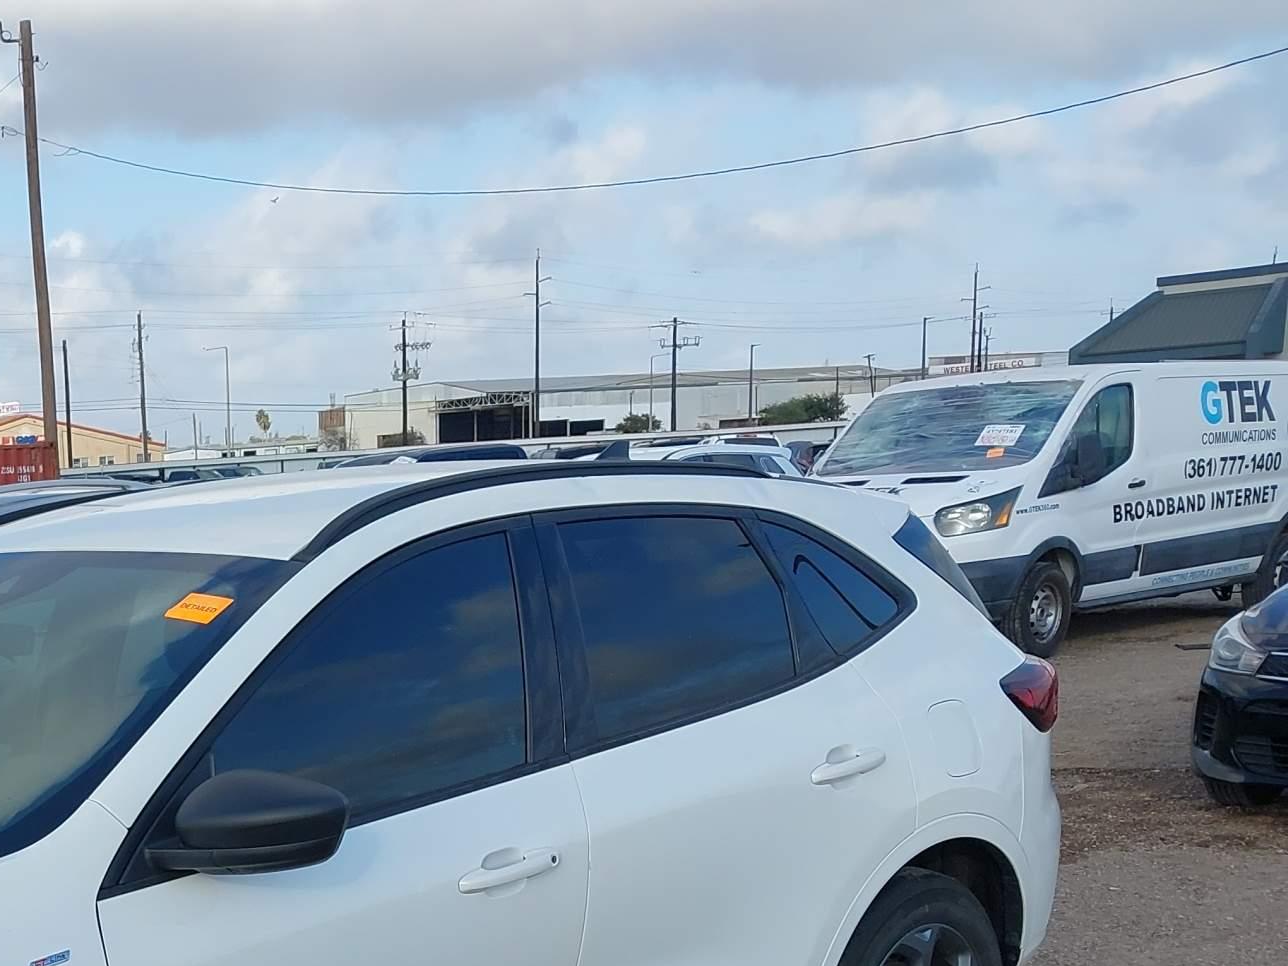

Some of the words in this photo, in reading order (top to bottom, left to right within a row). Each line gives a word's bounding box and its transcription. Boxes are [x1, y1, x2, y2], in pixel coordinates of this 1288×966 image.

[983, 361, 1009, 371] TEEL
[1200, 379, 1276, 425] GTEK
[1201, 428, 1277, 446] COMMUNICATIONS
[1183, 457, 1217, 480] (361)
[1220, 451, 1282, 476] 777-1400
[1112, 492, 1206, 524] BROADBAND
[1210, 484, 1278, 511] INTERNET
[180, 602, 218, 614] DETAILED
